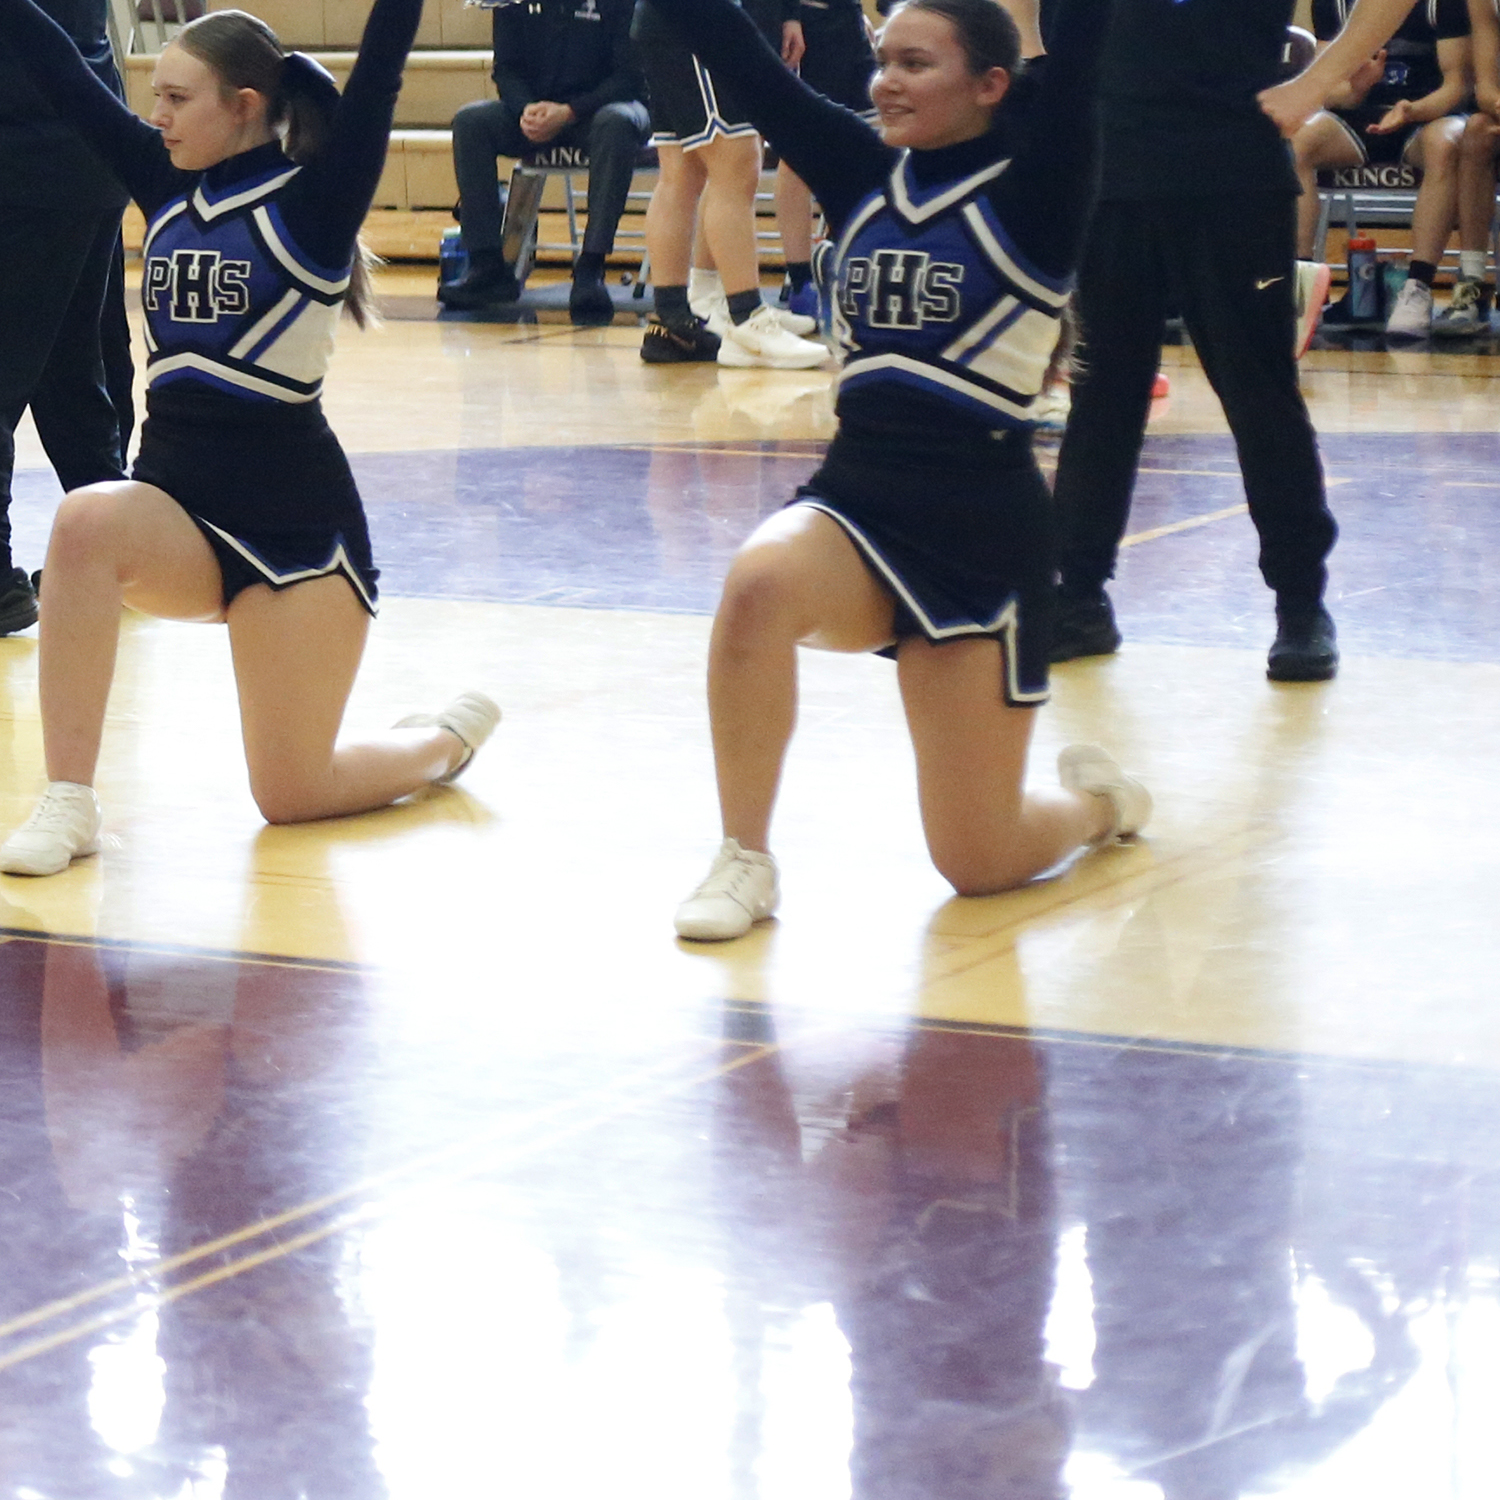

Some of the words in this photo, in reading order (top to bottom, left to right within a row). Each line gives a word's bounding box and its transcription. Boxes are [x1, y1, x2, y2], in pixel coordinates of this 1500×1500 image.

[535, 146, 590, 166] KING
[1334, 166, 1416, 187] KINGS
[146, 249, 251, 323] PHS
[843, 249, 964, 330] PHS
